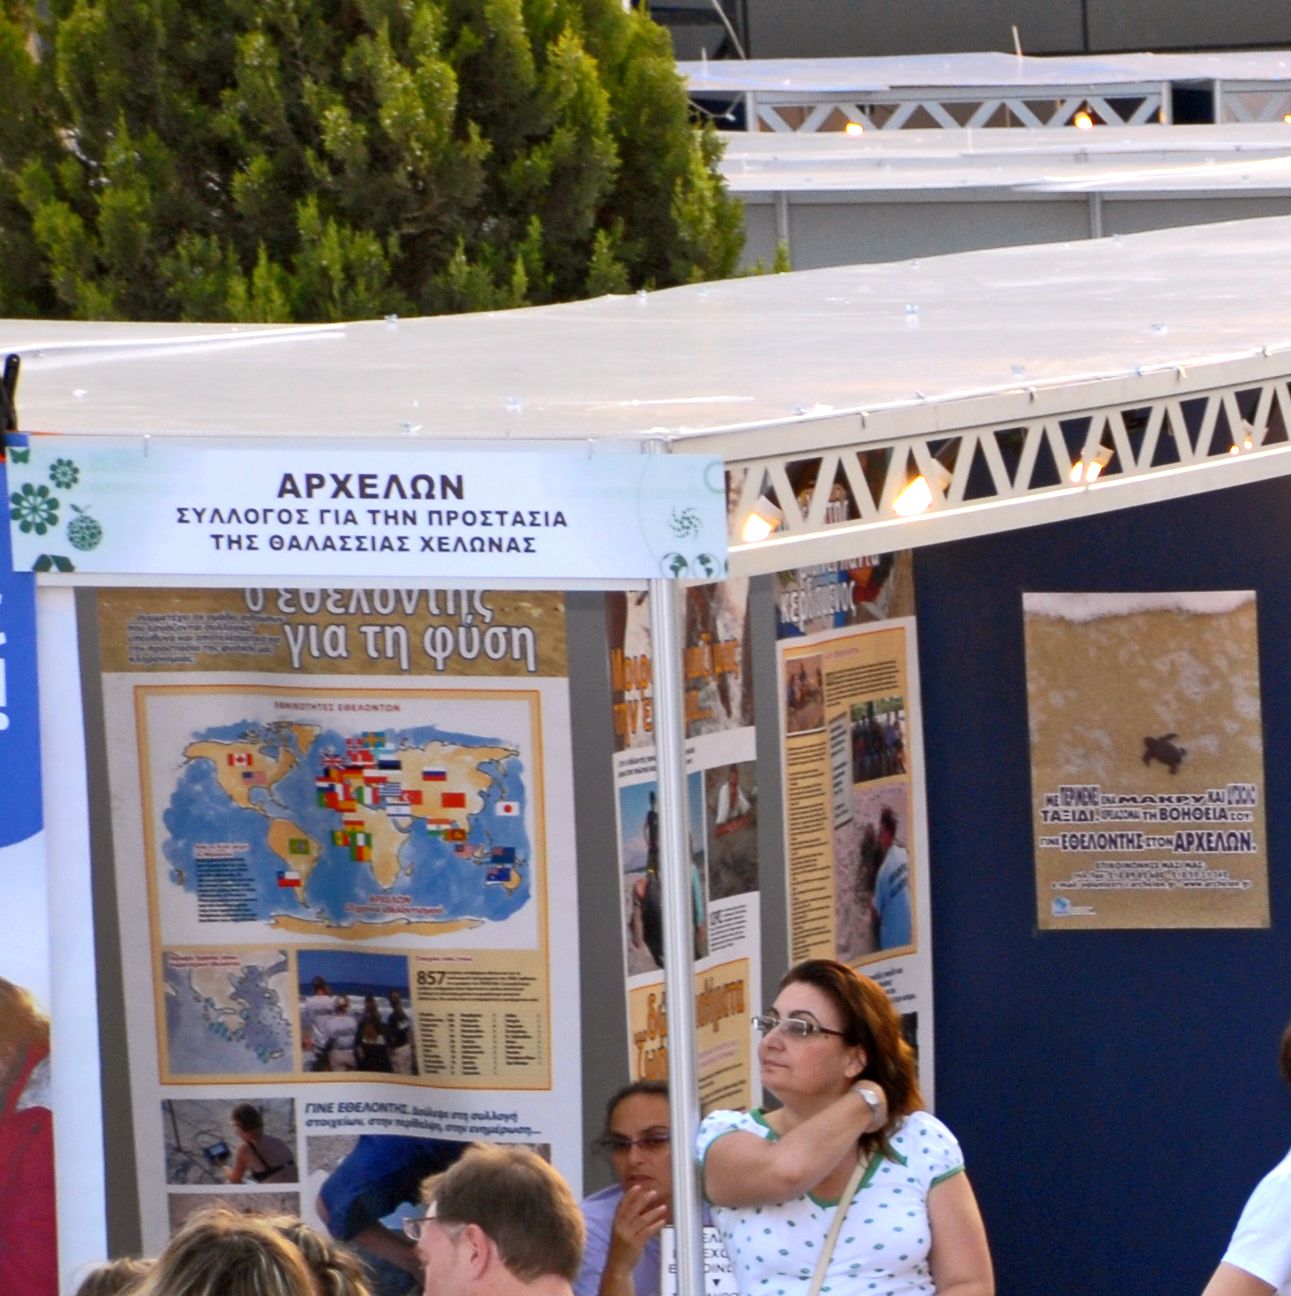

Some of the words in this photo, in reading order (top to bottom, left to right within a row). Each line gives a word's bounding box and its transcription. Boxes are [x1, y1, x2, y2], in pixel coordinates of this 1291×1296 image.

[276, 473, 466, 500] ΑΡΧΕΛΩΝ
[176, 507, 310, 526] ΣΥΛΛΟΓΟΣ
[318, 508, 361, 526] ΓΙΑ
[367, 508, 418, 527] ΤΗΝ
[428, 509, 568, 528] ΠΡΟΣΤΑΣΙΑ
[210, 534, 258, 552] ΤΗΣ
[269, 534, 409, 553] ΘΑΛΑΣΣΙΑΣ
[421, 535, 537, 554] ΧΕΛΩΝΑΣ
[282, 622, 348, 670] για
[359, 623, 411, 671] τη
[421, 613, 539, 672] φύση
[1118, 796, 1207, 804] ΜΑΚΡΥ
[1041, 810, 1100, 822] ΤΑΞΙΔΙ.
[1159, 807, 1229, 821] ΒΟΗΘΕΙΑ
[1061, 833, 1144, 850] ΕΘΕΛΟΝΤΗΣ
[416, 970, 446, 986] 857
[305, 1103, 333, 1114] ΓΙΝΕ
